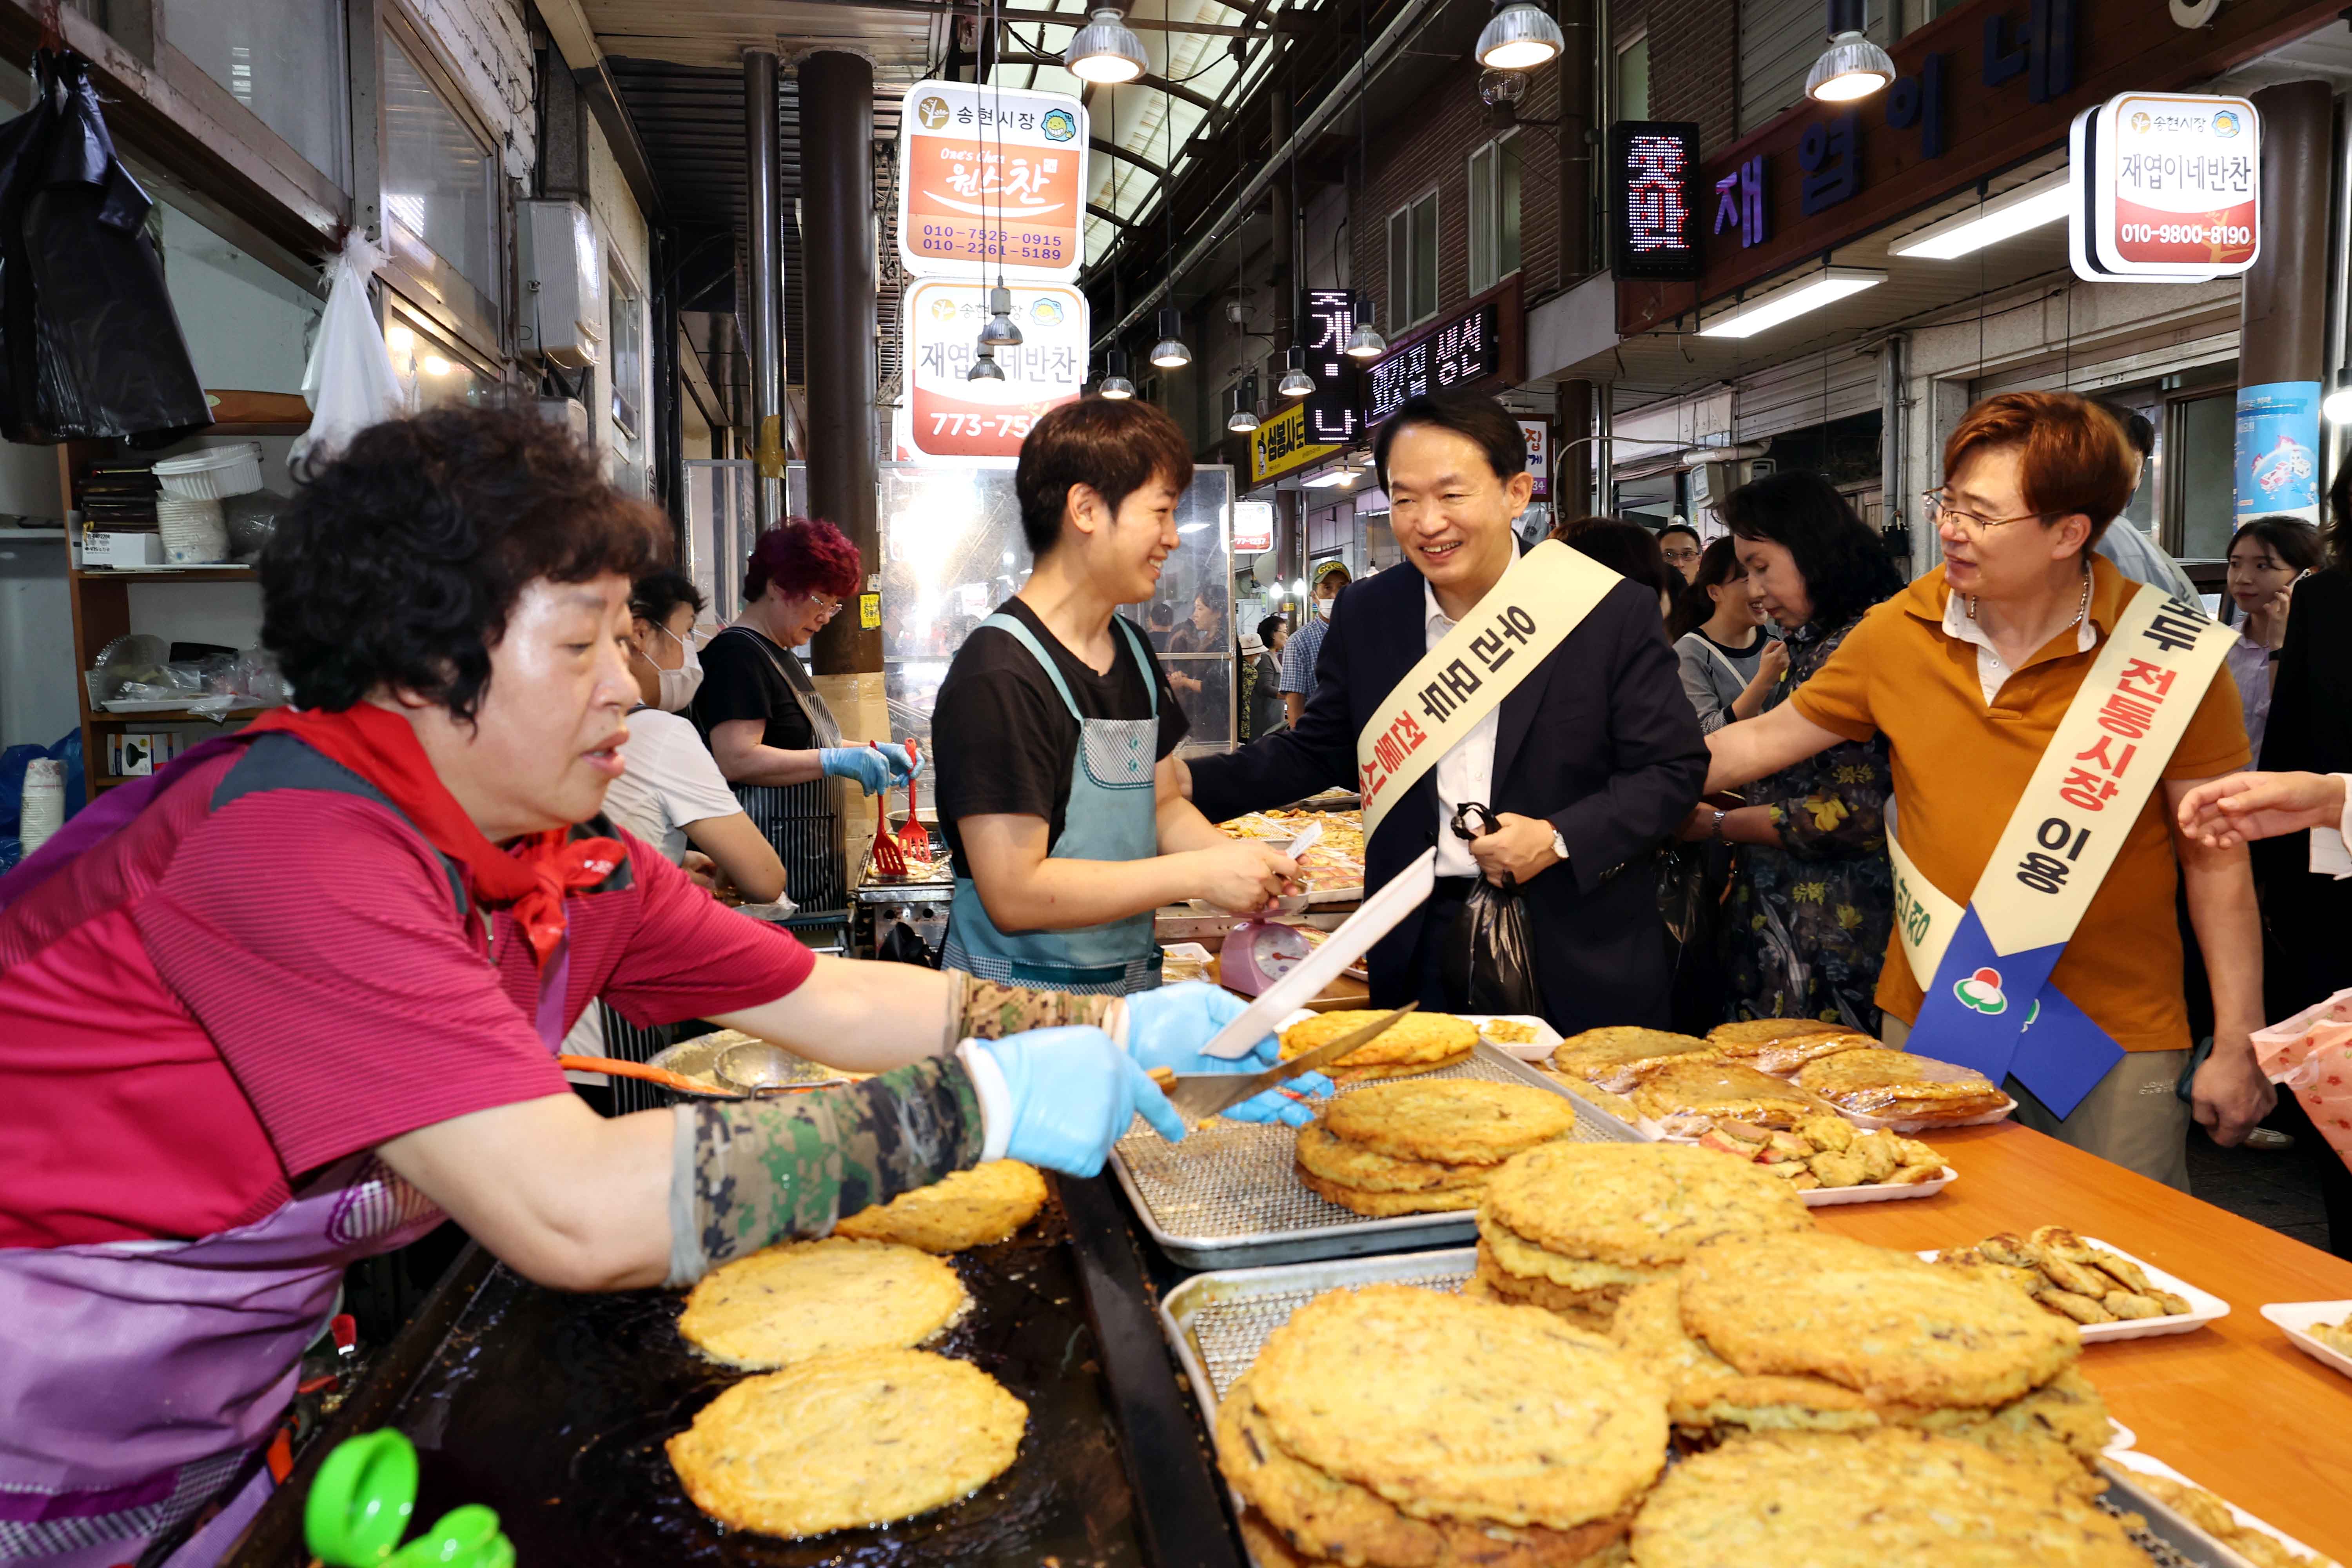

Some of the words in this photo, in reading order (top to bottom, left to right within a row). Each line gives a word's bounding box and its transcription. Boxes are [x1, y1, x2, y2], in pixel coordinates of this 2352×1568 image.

[956, 106, 1034, 130] 송현시장
[2153, 116, 2207, 132] 송현시장
[940, 148, 973, 161] One's
[946, 158, 1050, 204] 원스찬
[2122, 153, 2251, 192] 재엽이네반찬
[923, 239, 1061, 260] 010-2261-5189
[924, 225, 1062, 247] 010-7526-0915
[2121, 223, 2250, 245] 010-9800-8190
[959, 303, 1023, 321] 송현장
[921, 341, 1077, 384] 재엽네반찬
[1436, 313, 1481, 386] 생선
[930, 412, 1043, 438] 773-75
[1469, 606, 1537, 673] 우리
[1417, 658, 1483, 723] 모두
[2058, 658, 2178, 811] 전통시장
[2016, 817, 2092, 895] 이용
